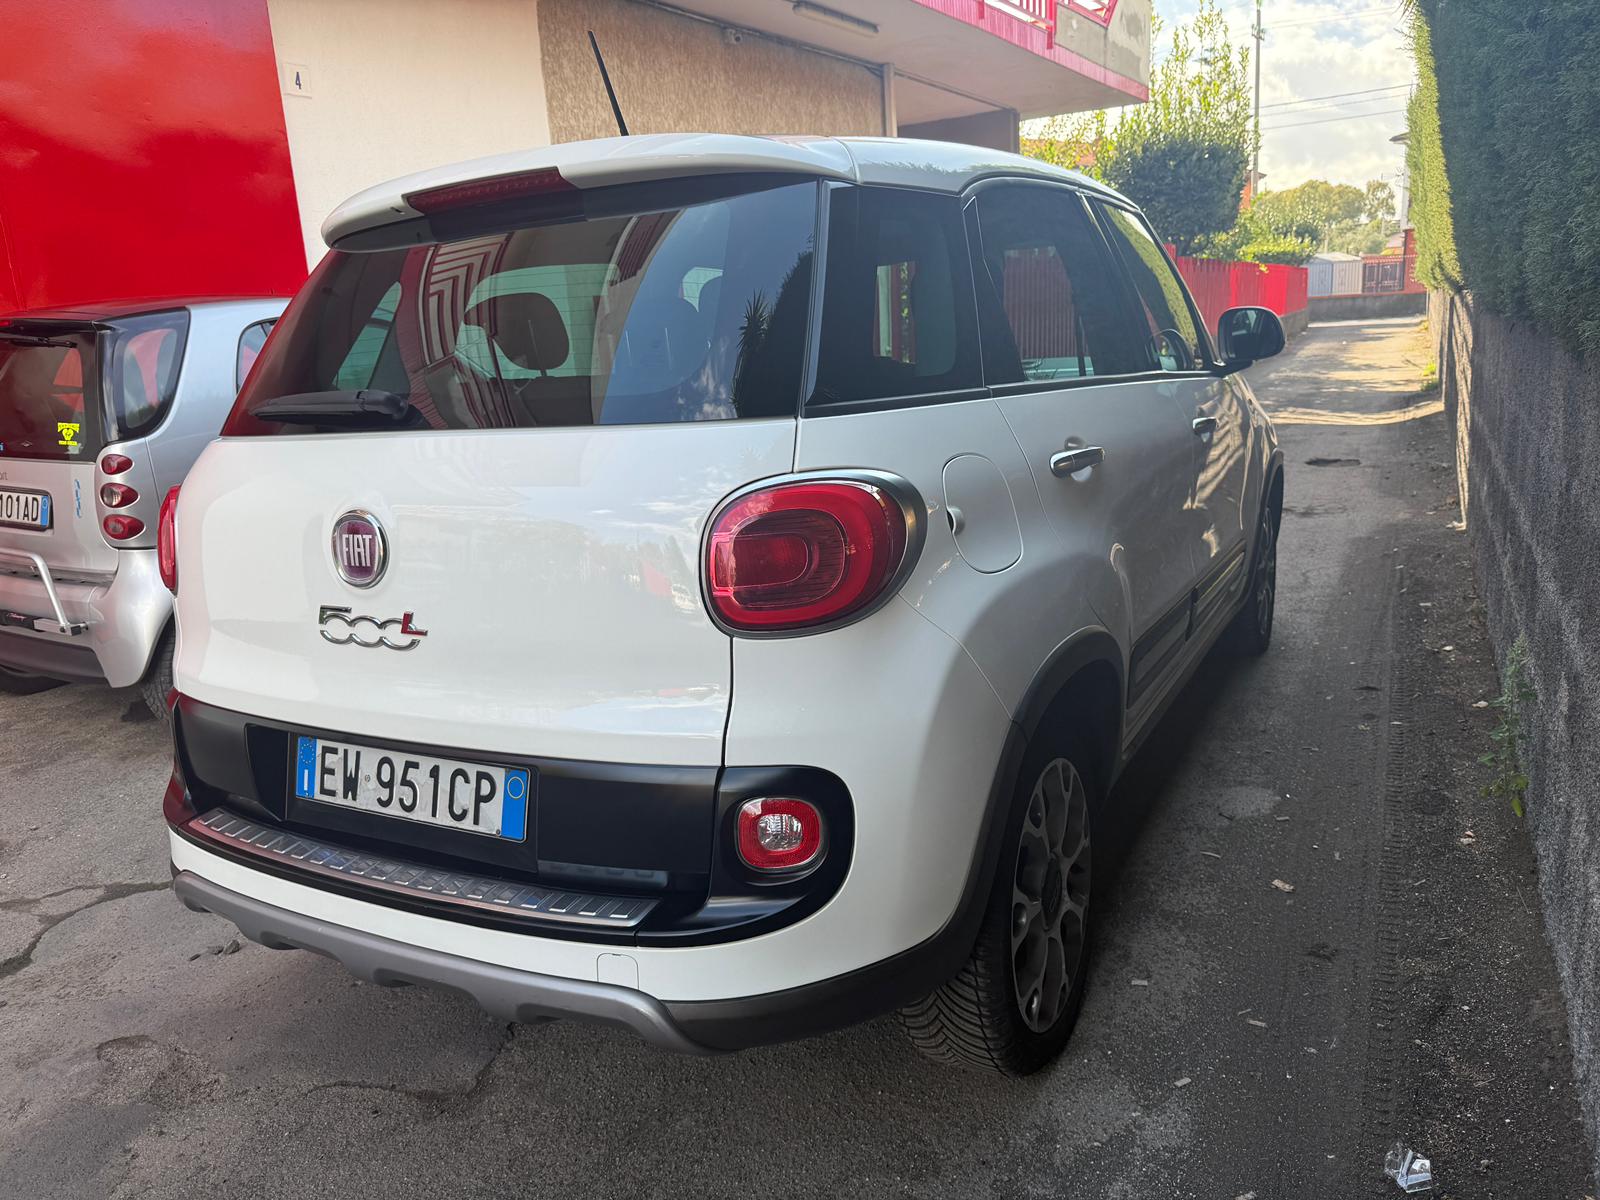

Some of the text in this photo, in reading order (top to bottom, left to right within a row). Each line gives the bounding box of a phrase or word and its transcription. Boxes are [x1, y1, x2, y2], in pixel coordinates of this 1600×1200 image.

[295, 71, 302, 90] 4
[341, 533, 372, 568] FIAT
[318, 604, 429, 651] 500L
